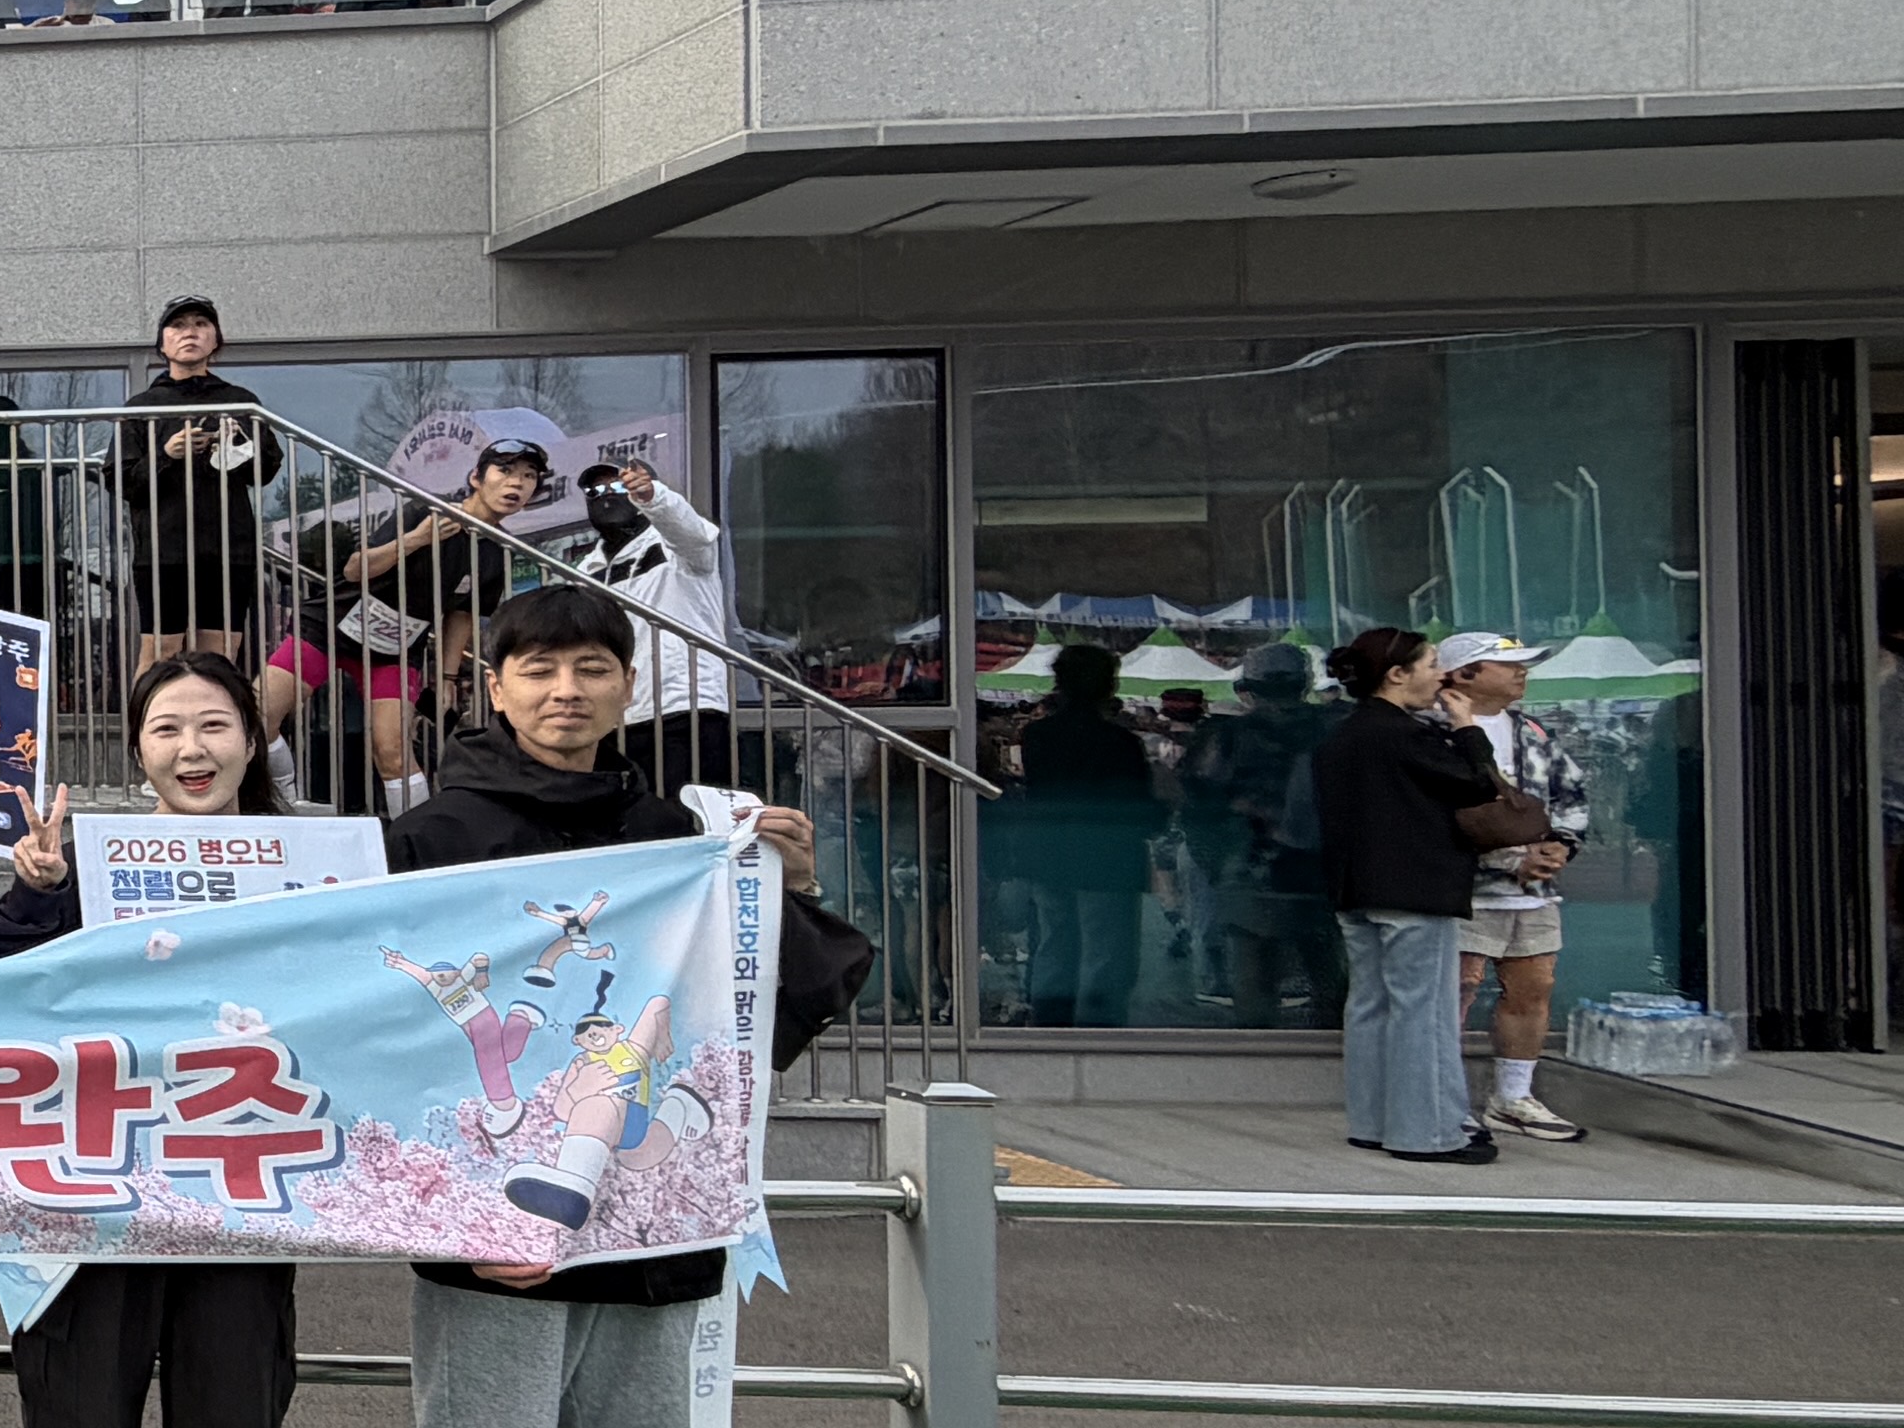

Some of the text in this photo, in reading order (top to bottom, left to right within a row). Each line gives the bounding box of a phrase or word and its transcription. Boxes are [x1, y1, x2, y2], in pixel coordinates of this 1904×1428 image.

[106, 837, 284, 865] 2026 병오년
[109, 869, 237, 903] 청렴으로
[734, 875, 761, 981] 합천호와
[734, 989, 756, 1042] 맑은
